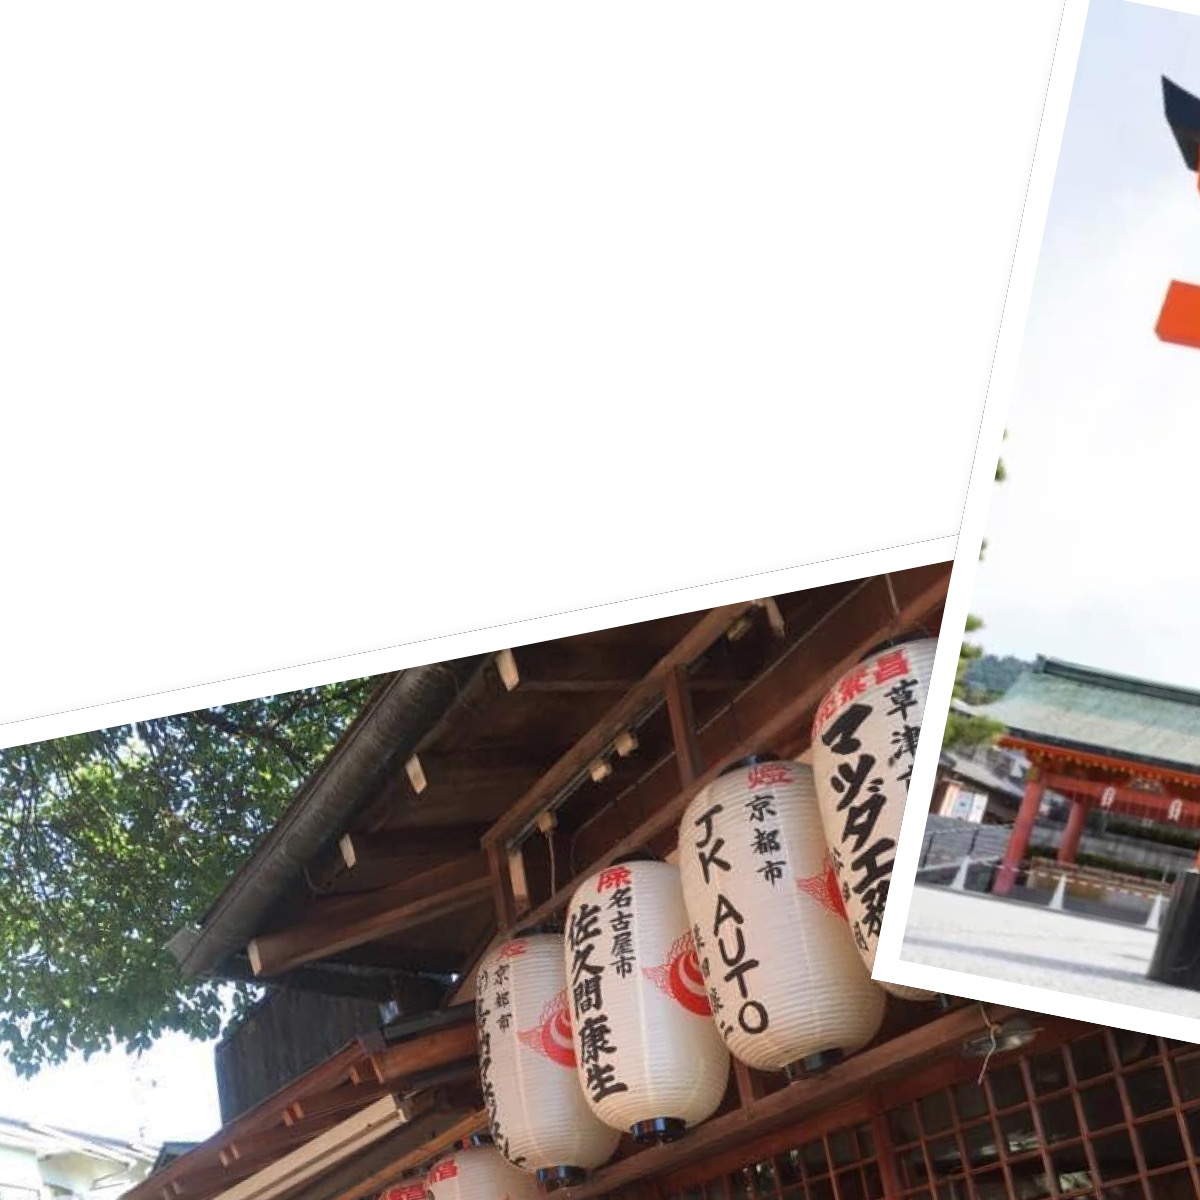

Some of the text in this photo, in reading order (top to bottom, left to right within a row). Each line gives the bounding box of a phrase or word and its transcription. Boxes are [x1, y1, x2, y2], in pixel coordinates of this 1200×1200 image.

[746, 795, 787, 888] 京都市
[609, 887, 636, 978] 名古屋市
[695, 804, 731, 884] JK
[714, 894, 769, 1034] AUTO
[569, 904, 628, 1102] 佐久間康生
